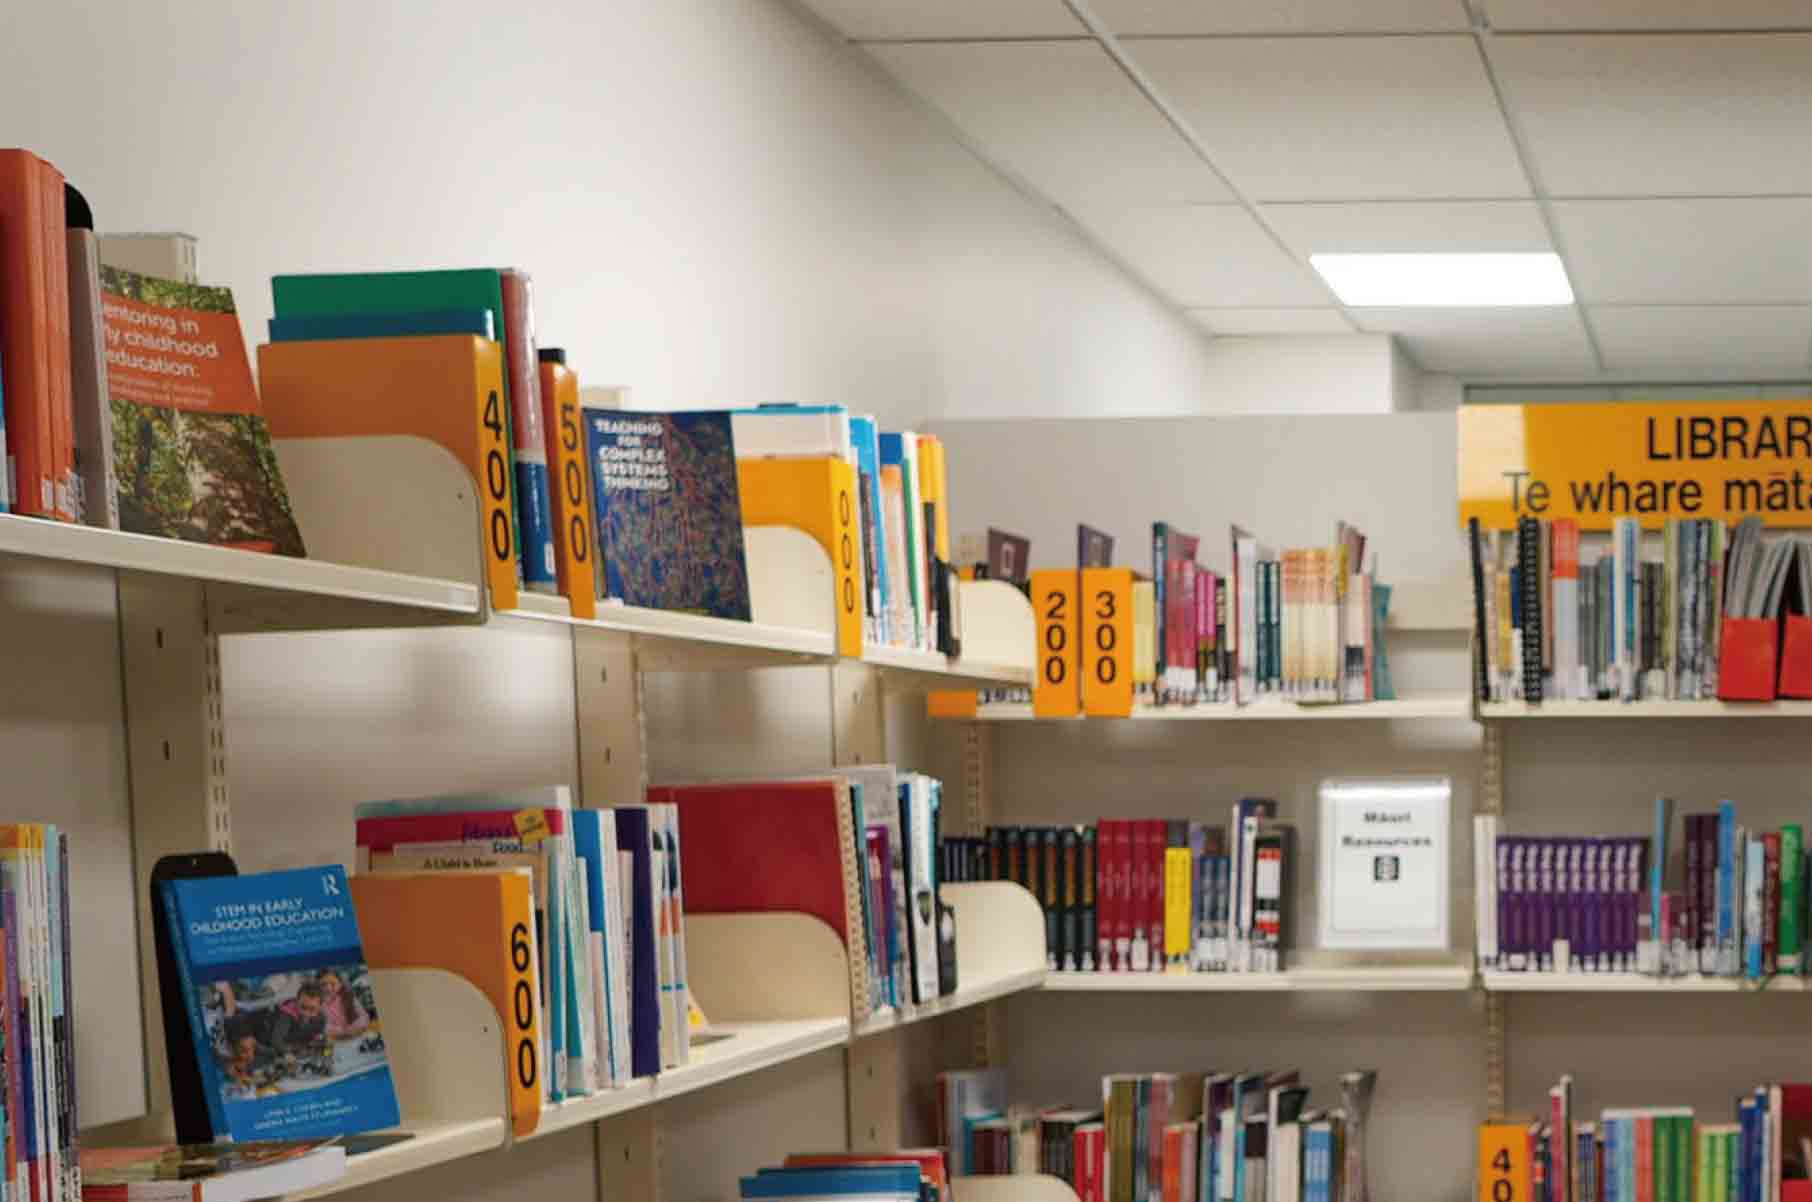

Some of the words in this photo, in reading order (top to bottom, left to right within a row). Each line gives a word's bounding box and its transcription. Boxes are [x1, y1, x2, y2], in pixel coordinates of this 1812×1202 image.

[103, 304, 177, 329] entoring
[483, 388, 511, 562] 400
[598, 447, 667, 462] COMPLEX
[601, 462, 669, 478] SYSTEMS
[561, 405, 589, 564] 500
[1503, 471, 1551, 513] Te
[1570, 472, 1703, 513] whare
[1045, 590, 1068, 684] 200
[1095, 590, 1117, 684] 300
[215, 905, 250, 920] STEM
[265, 898, 303, 912] EARLY
[265, 906, 344, 926] EDUCATION
[511, 922, 537, 1089] 600
